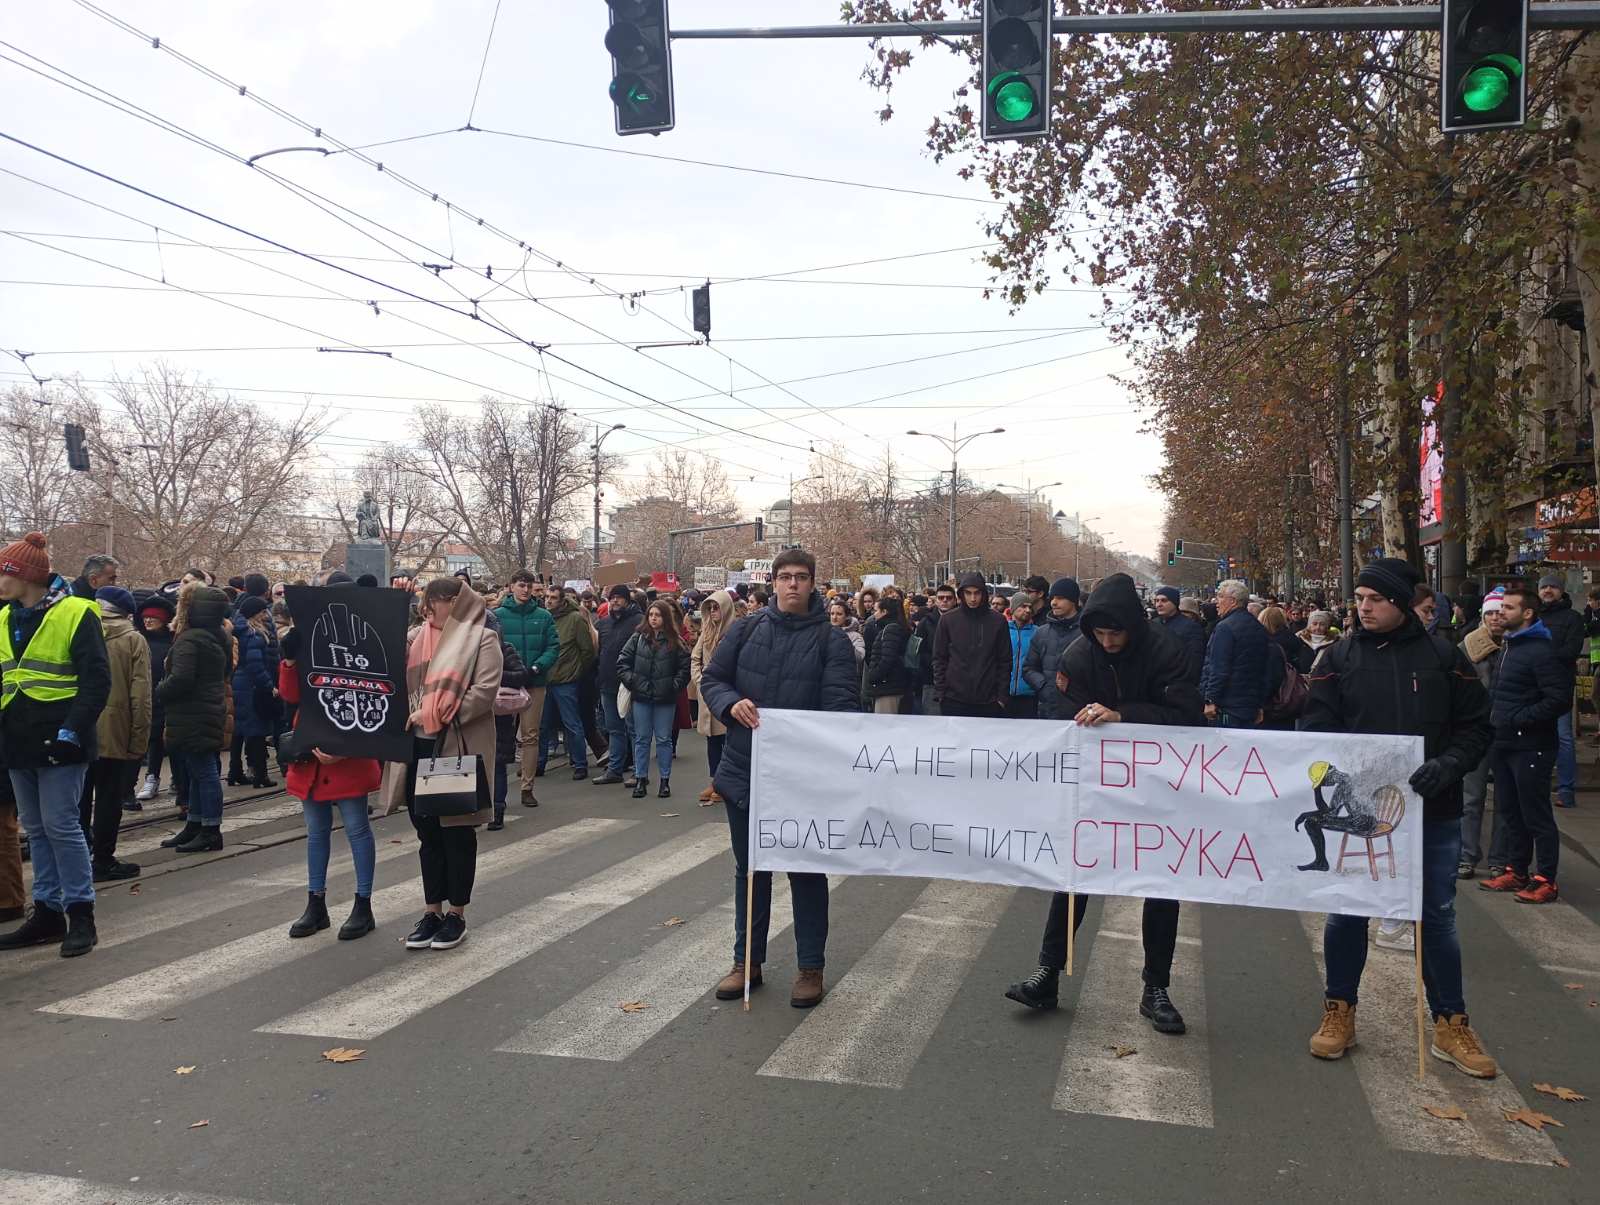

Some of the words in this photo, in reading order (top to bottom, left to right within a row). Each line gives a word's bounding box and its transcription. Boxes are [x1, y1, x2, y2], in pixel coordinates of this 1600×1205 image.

[852, 744, 899, 774] ДА
[914, 746, 957, 777] НЕ
[970, 748, 1081, 785] ПУКНЕ
[1100, 739, 1279, 798] БРУКА
[758, 818, 848, 850] БОЉЕ
[858, 820, 901, 849] ДА
[909, 822, 953, 854] СЕ
[968, 826, 1058, 864] ПИТА
[1072, 819, 1264, 882] СТРУКА
